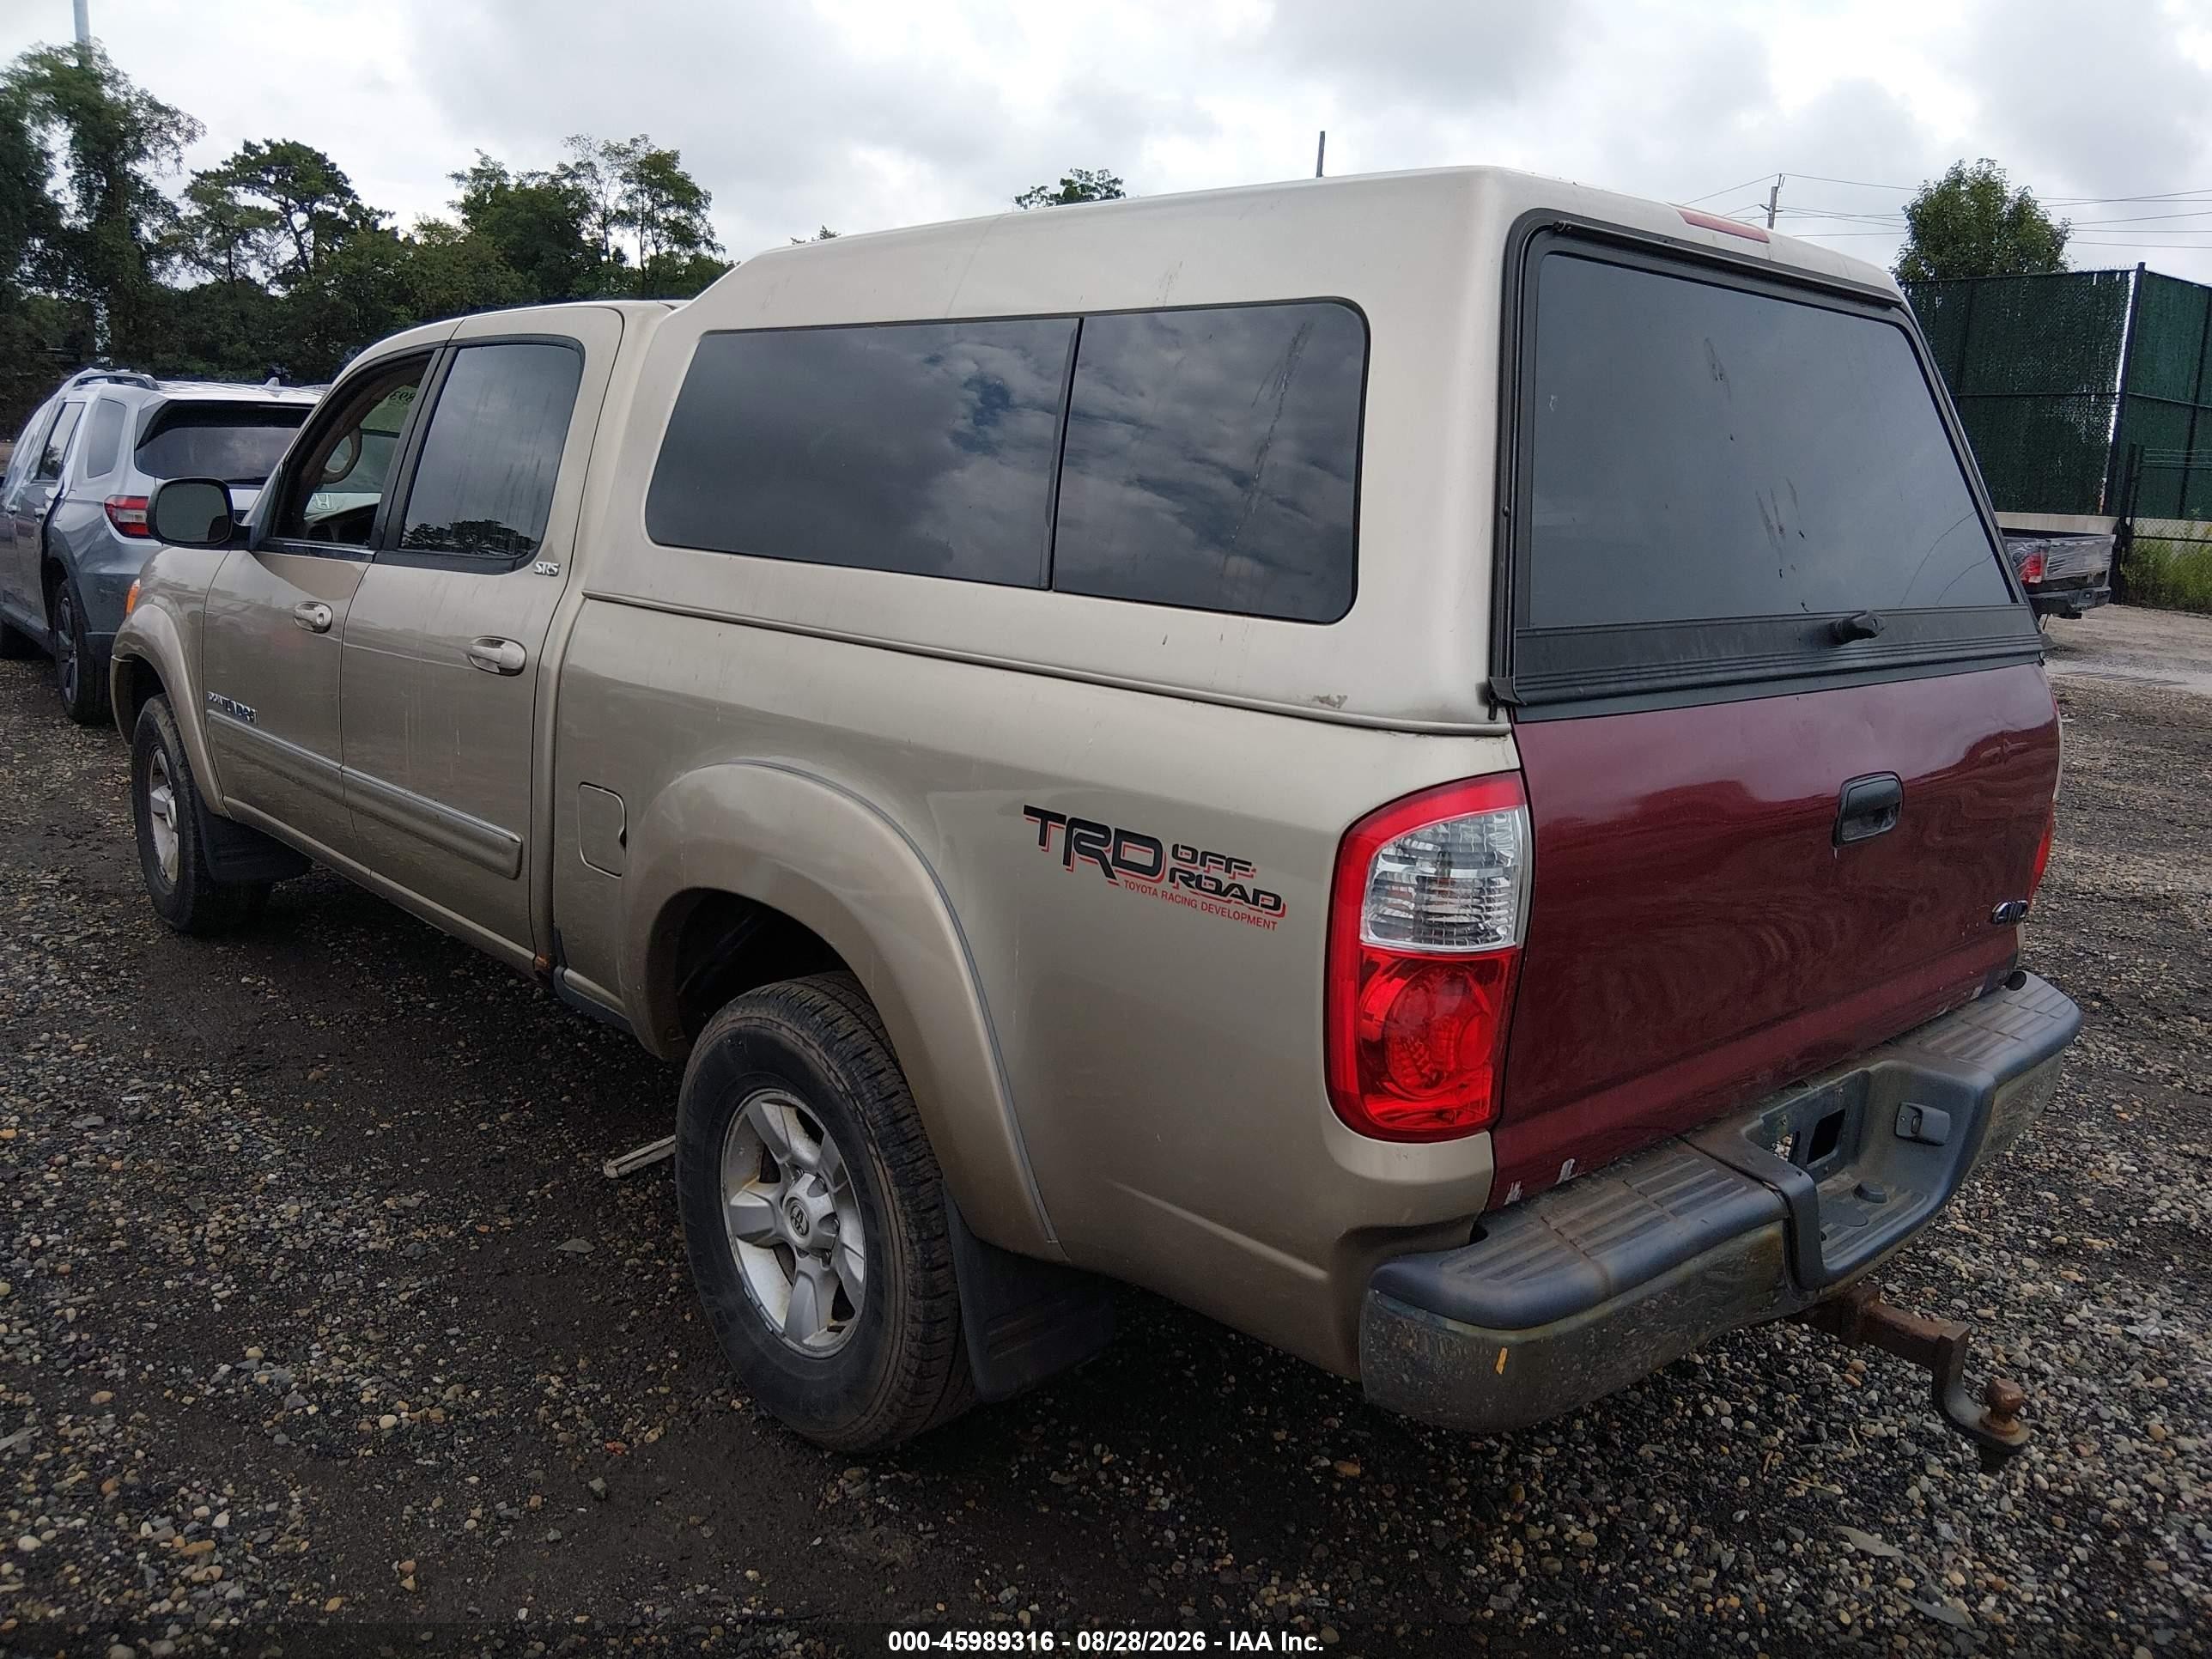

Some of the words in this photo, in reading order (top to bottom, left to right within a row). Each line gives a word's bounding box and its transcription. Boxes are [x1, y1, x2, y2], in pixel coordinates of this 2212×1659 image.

[1024, 804, 1166, 886] TRD
[1171, 843, 1256, 879] OFF
[1124, 878, 1158, 897] TOYOTA
[1161, 890, 1197, 909] RACING
[1200, 902, 1278, 931] DEVELOPMENT
[1169, 866, 1286, 918] ROAD
